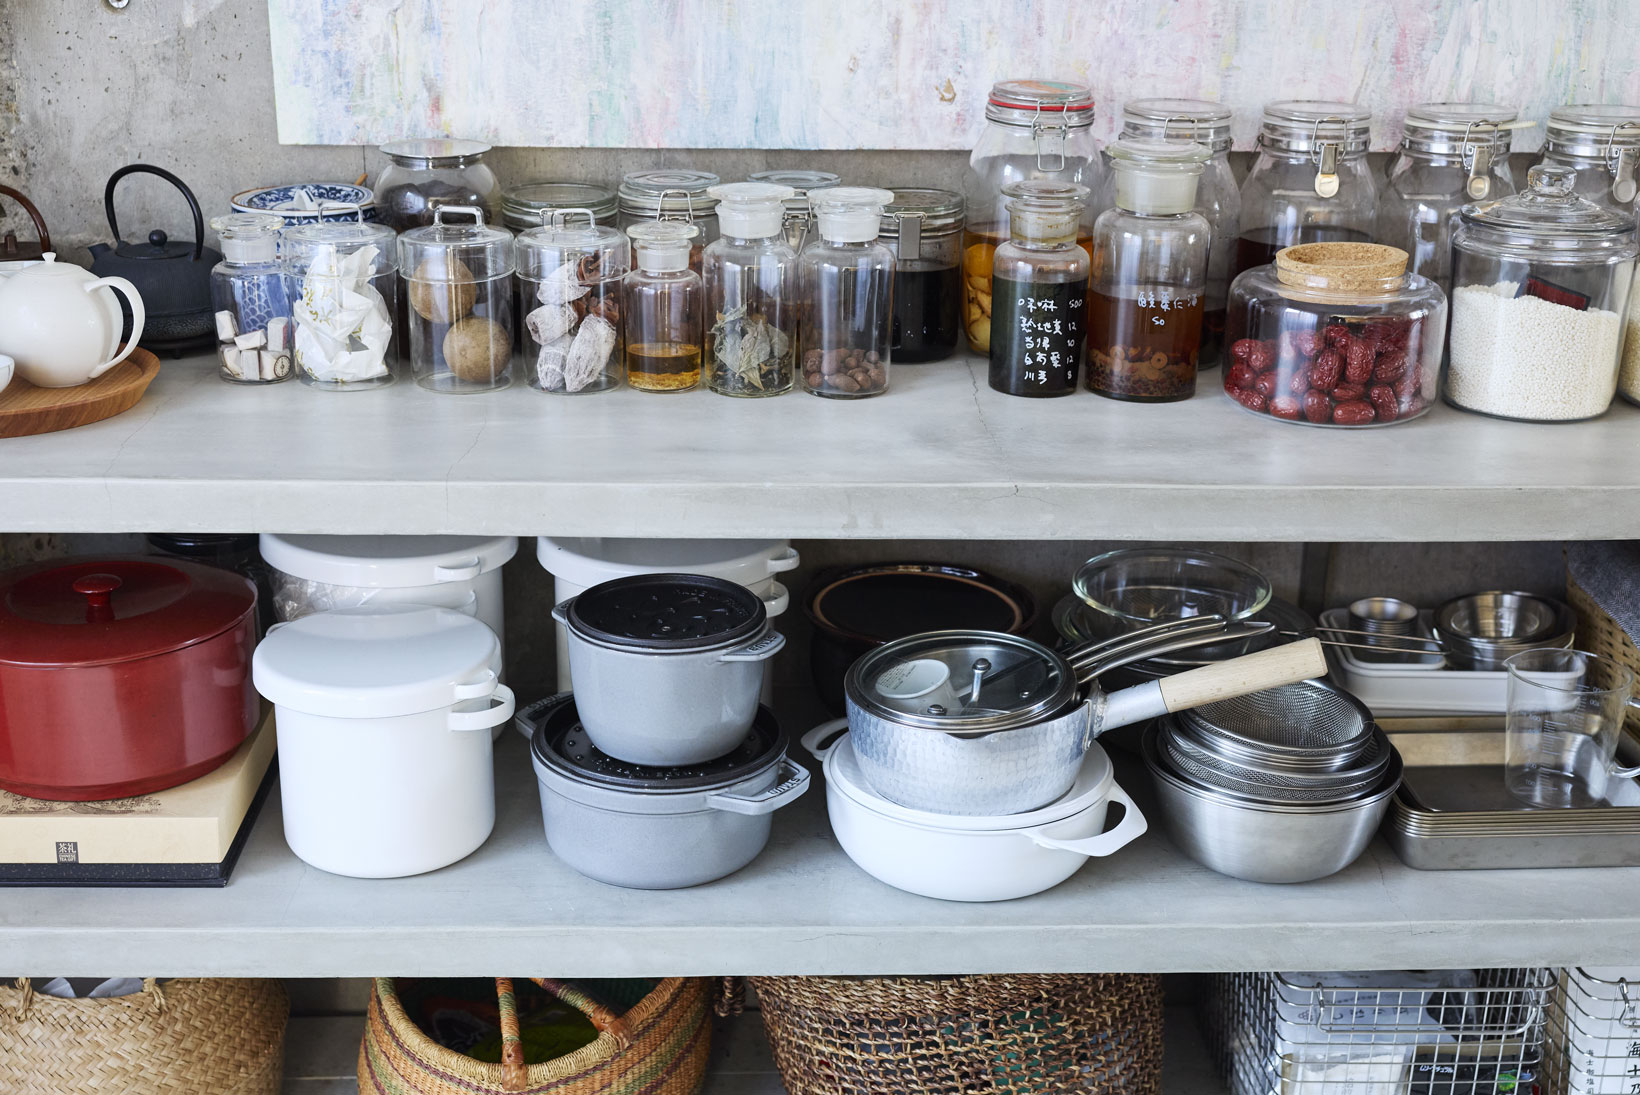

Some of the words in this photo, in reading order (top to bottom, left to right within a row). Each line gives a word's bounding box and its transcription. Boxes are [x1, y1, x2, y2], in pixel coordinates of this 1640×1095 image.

[1068, 299, 1083, 309] 500
[1068, 321, 1077, 332] 12
[1067, 339, 1076, 347] 10
[1066, 355, 1074, 365] 12
[1067, 370, 1073, 380] 8
[767, 778, 801, 795] STAUB
